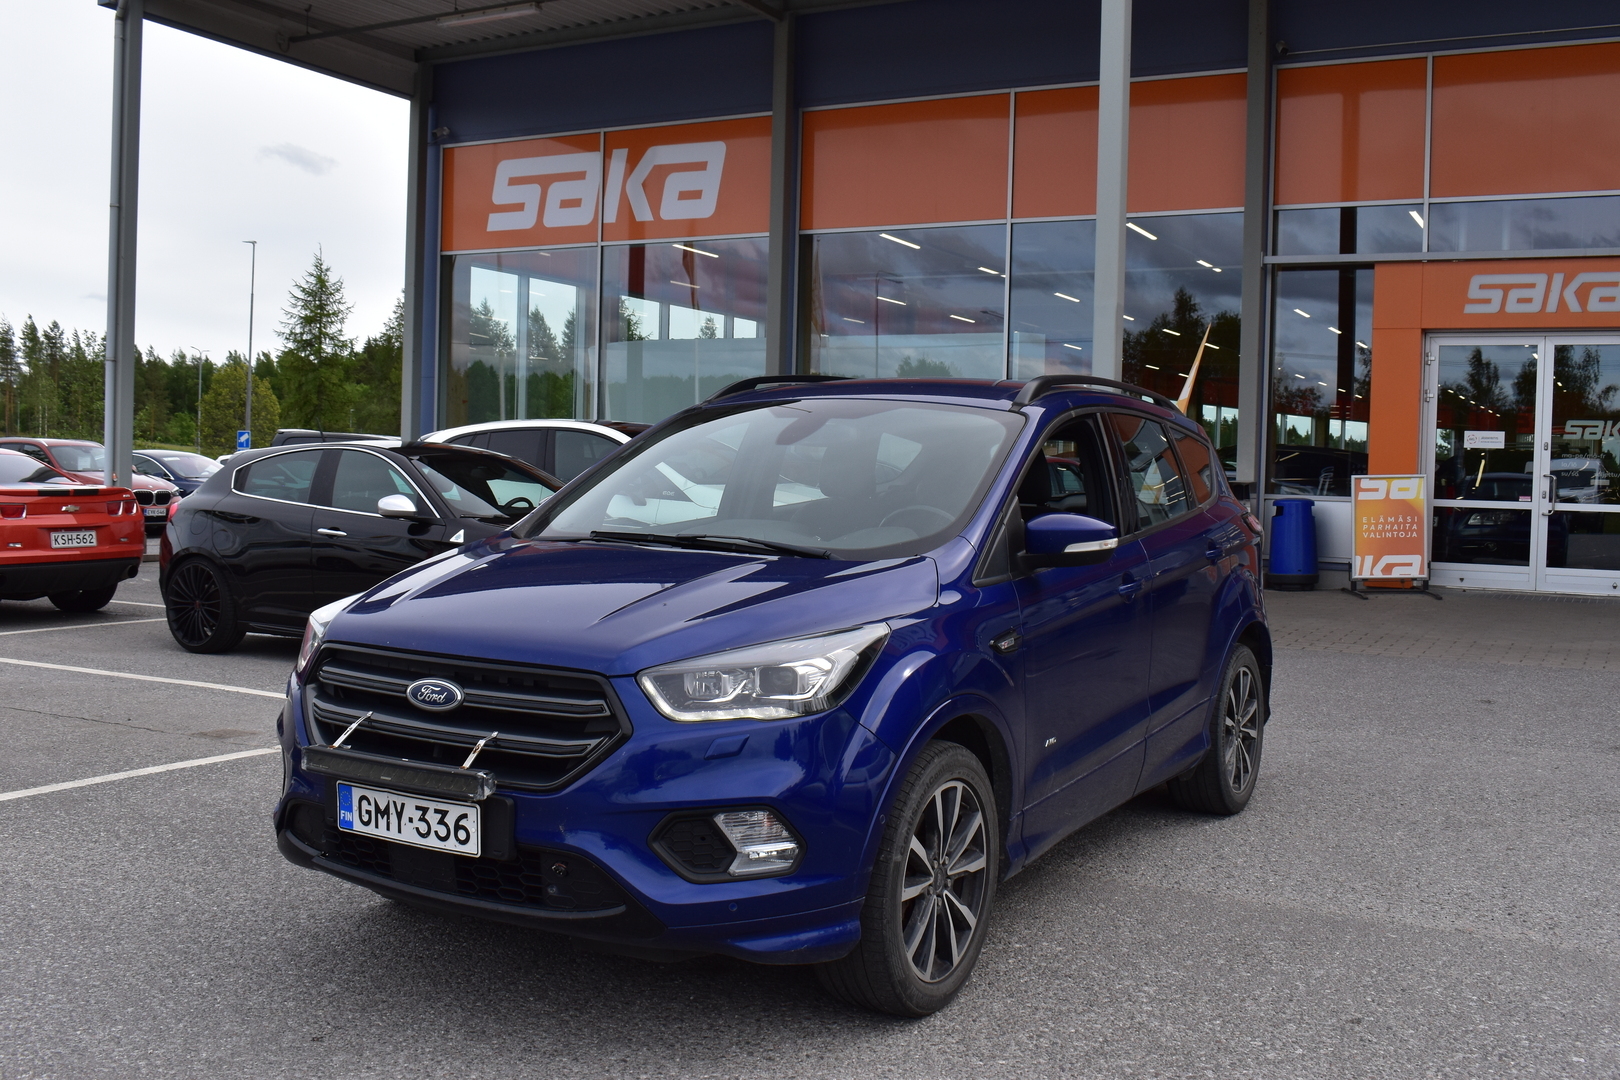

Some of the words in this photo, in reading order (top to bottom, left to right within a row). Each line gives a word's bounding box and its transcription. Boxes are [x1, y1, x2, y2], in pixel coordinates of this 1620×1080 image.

[1362, 515, 1418, 523] ELÄMÄSI
[53, 533, 95, 546] KSH-562
[417, 685, 448, 704] Ford
[340, 810, 353, 822] FIN
[358, 794, 471, 846] GMY-336
